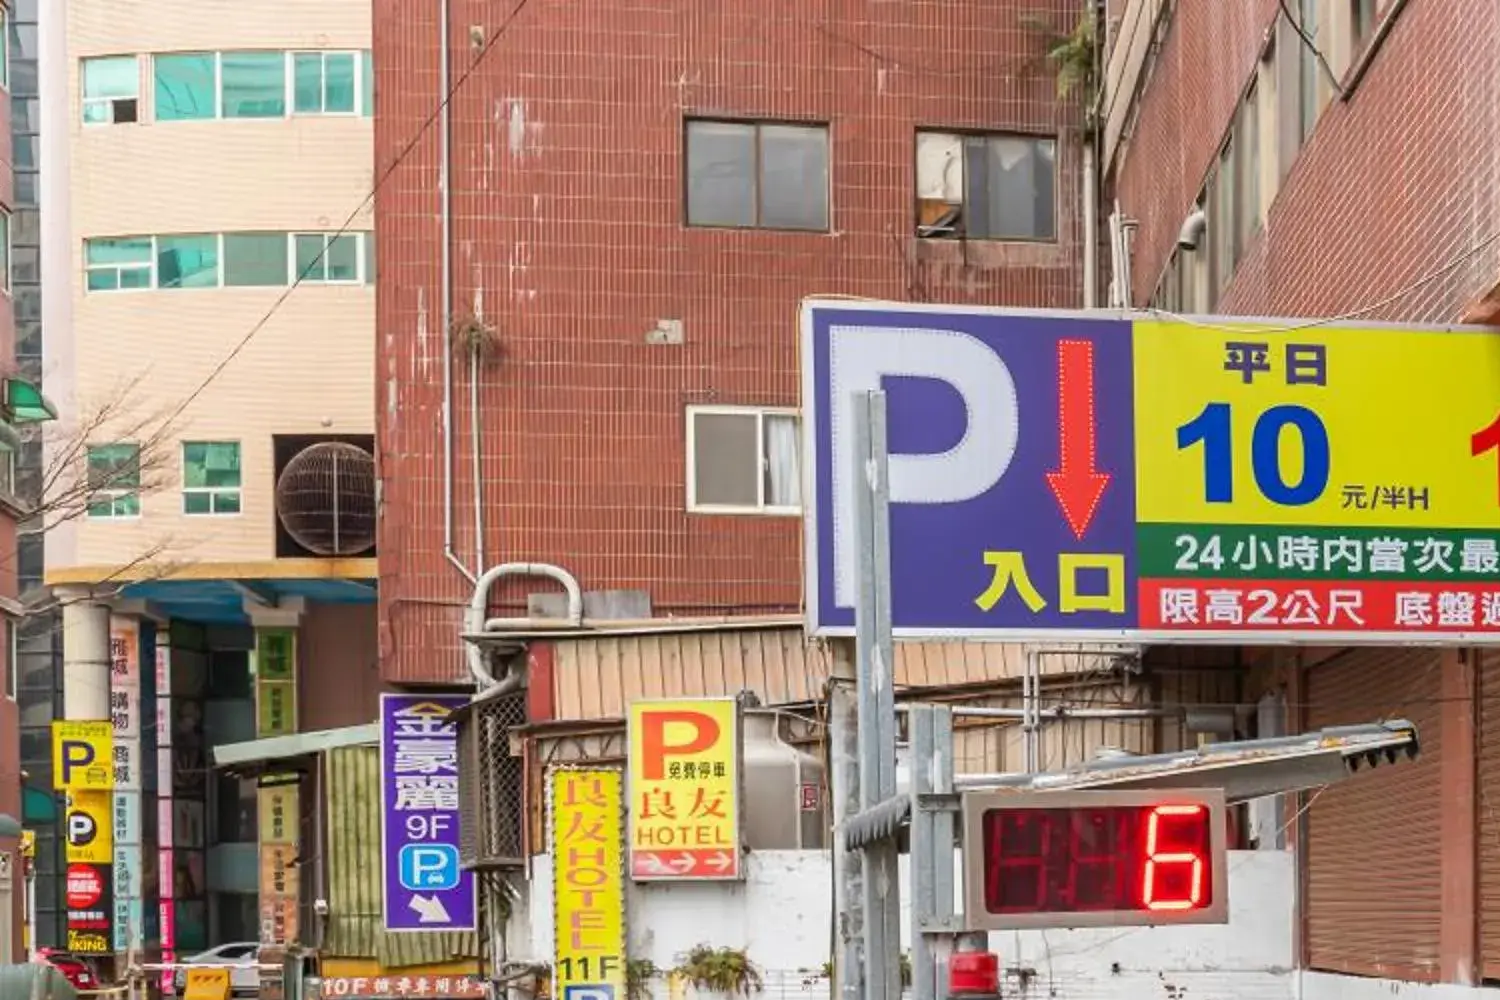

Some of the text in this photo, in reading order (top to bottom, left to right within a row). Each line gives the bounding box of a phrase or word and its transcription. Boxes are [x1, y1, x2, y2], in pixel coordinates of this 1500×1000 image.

[1223, 341, 1329, 386] 平日
[830, 324, 1018, 607] P
[1177, 401, 1430, 512] 10 元/半H
[975, 550, 1125, 614] 入口
[1160, 588, 1365, 628] 限高2公尺
[62, 740, 95, 784] P
[393, 702, 458, 810] 金豪麗
[641, 711, 721, 781] P
[669, 760, 725, 779] 免費停車
[640, 787, 726, 819] 良友
[69, 813, 94, 845] P
[406, 815, 451, 840] 9F
[637, 825, 729, 845] HOTEL
[412, 850, 448, 884] P
[1143, 805, 1202, 910] 6
[323, 977, 368, 995] 10F
[560, 955, 619, 981] 11F
